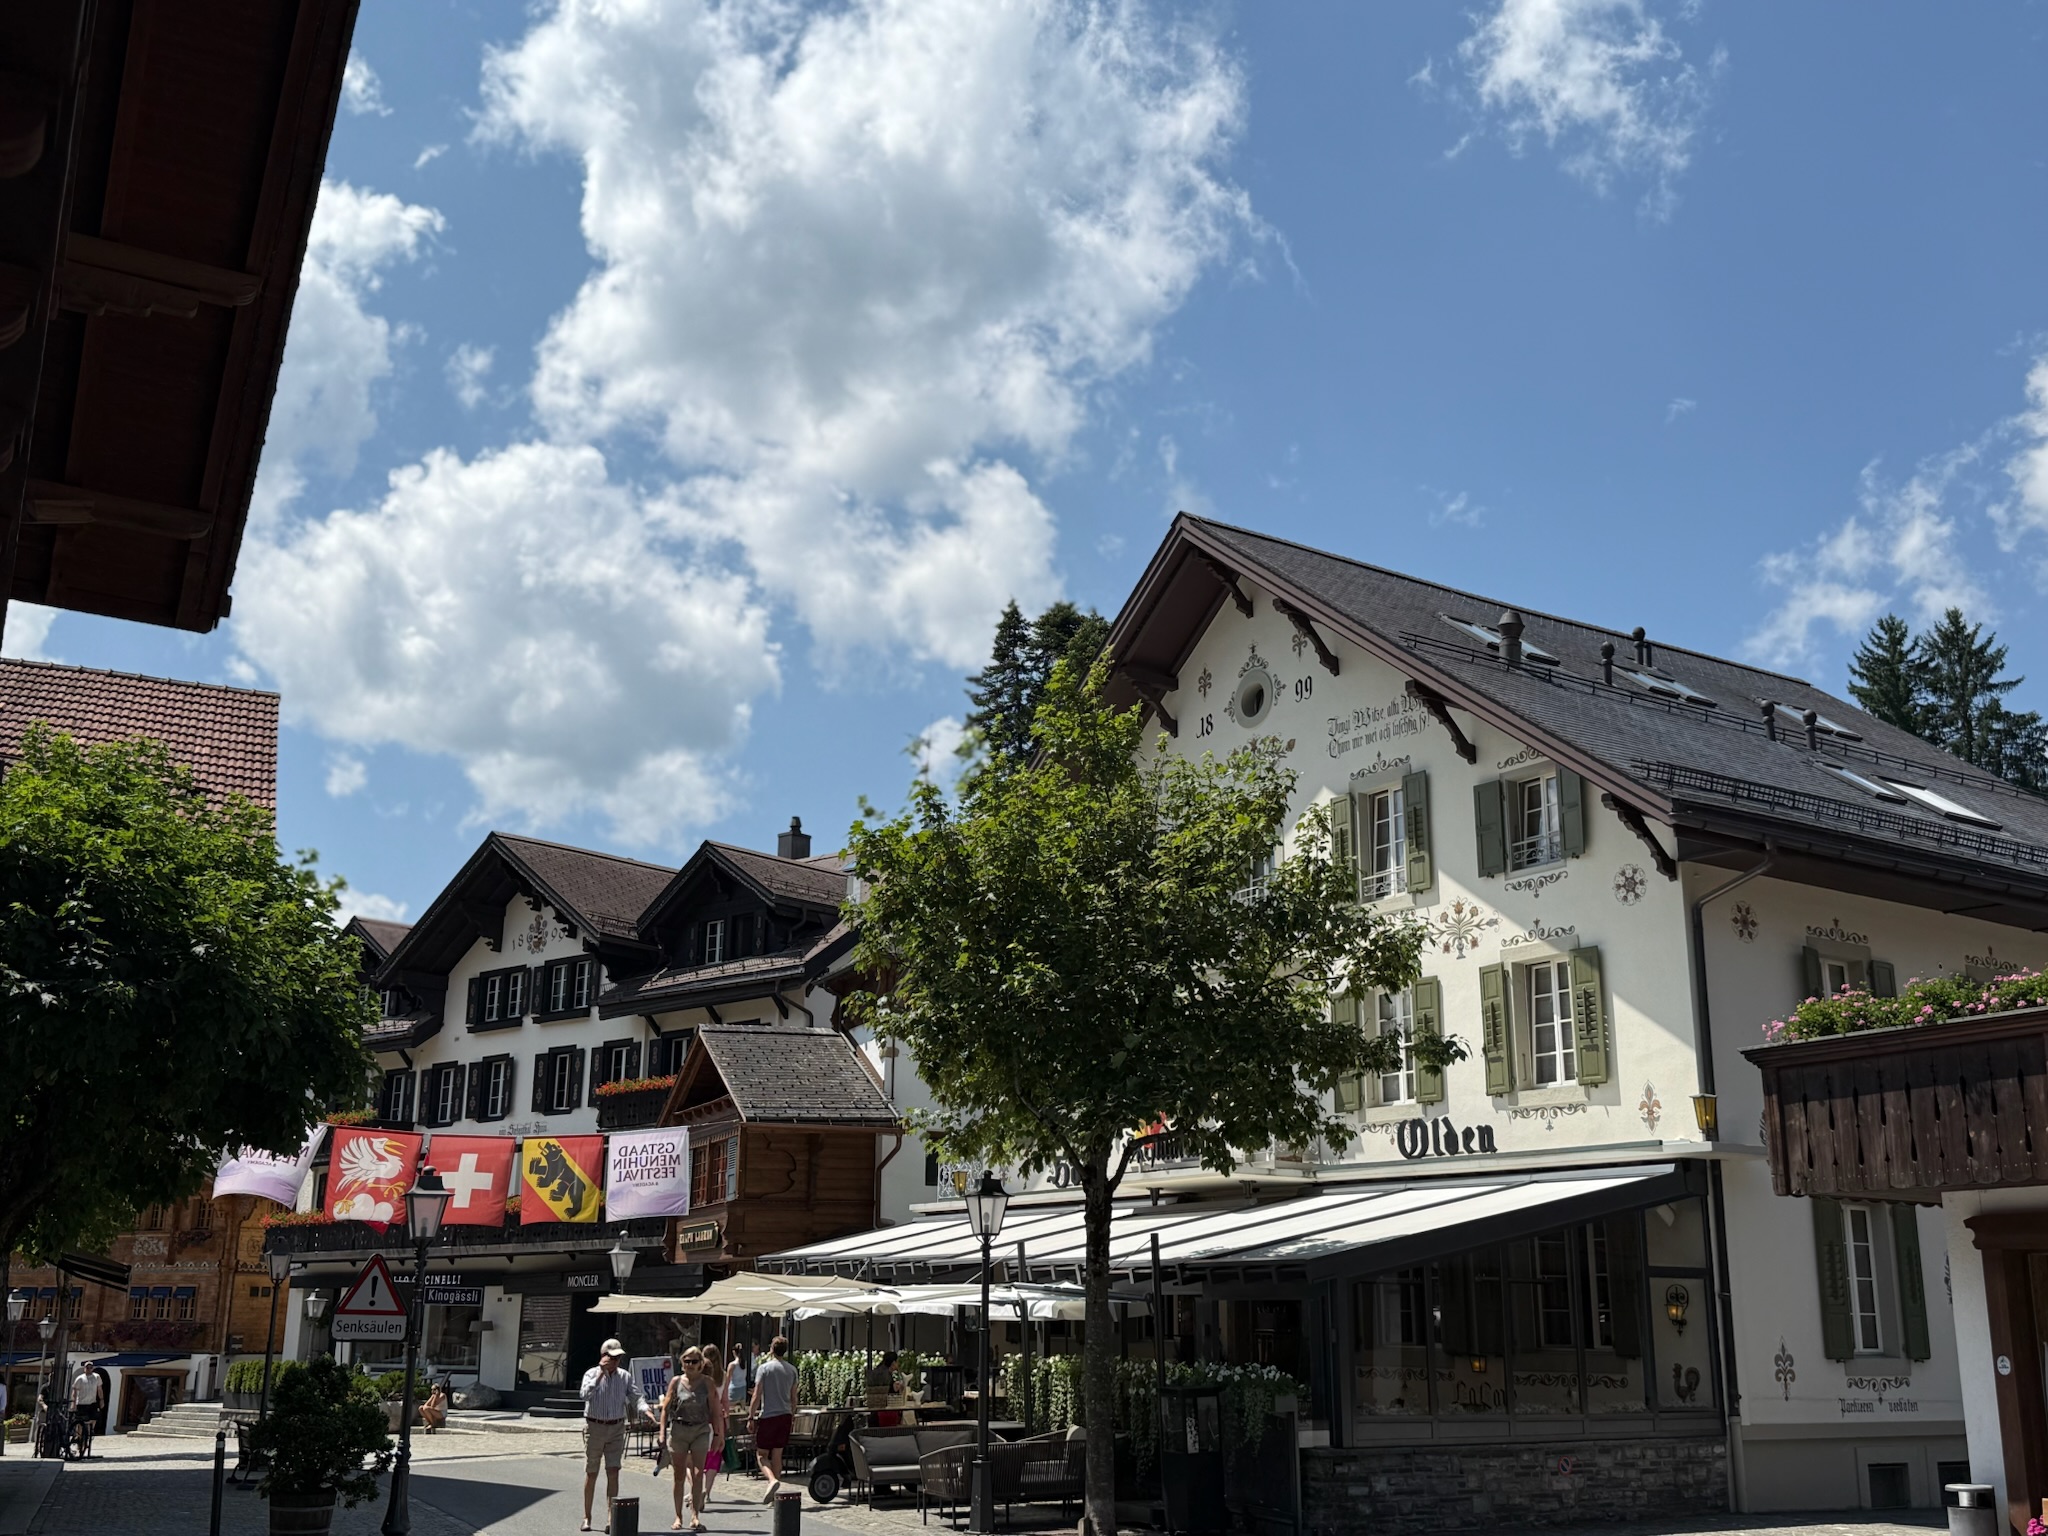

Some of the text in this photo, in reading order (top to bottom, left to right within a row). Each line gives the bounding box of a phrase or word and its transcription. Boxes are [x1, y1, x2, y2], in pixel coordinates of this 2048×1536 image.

[1197, 676, 1312, 738] 18 99
[1397, 1116, 1498, 1160] Olden
[567, 1274, 600, 1288] MONCLER
[428, 1289, 479, 1304] Kinogässli
[336, 1320, 402, 1334] Senksäulen
[642, 1368, 667, 1384] BLUE
